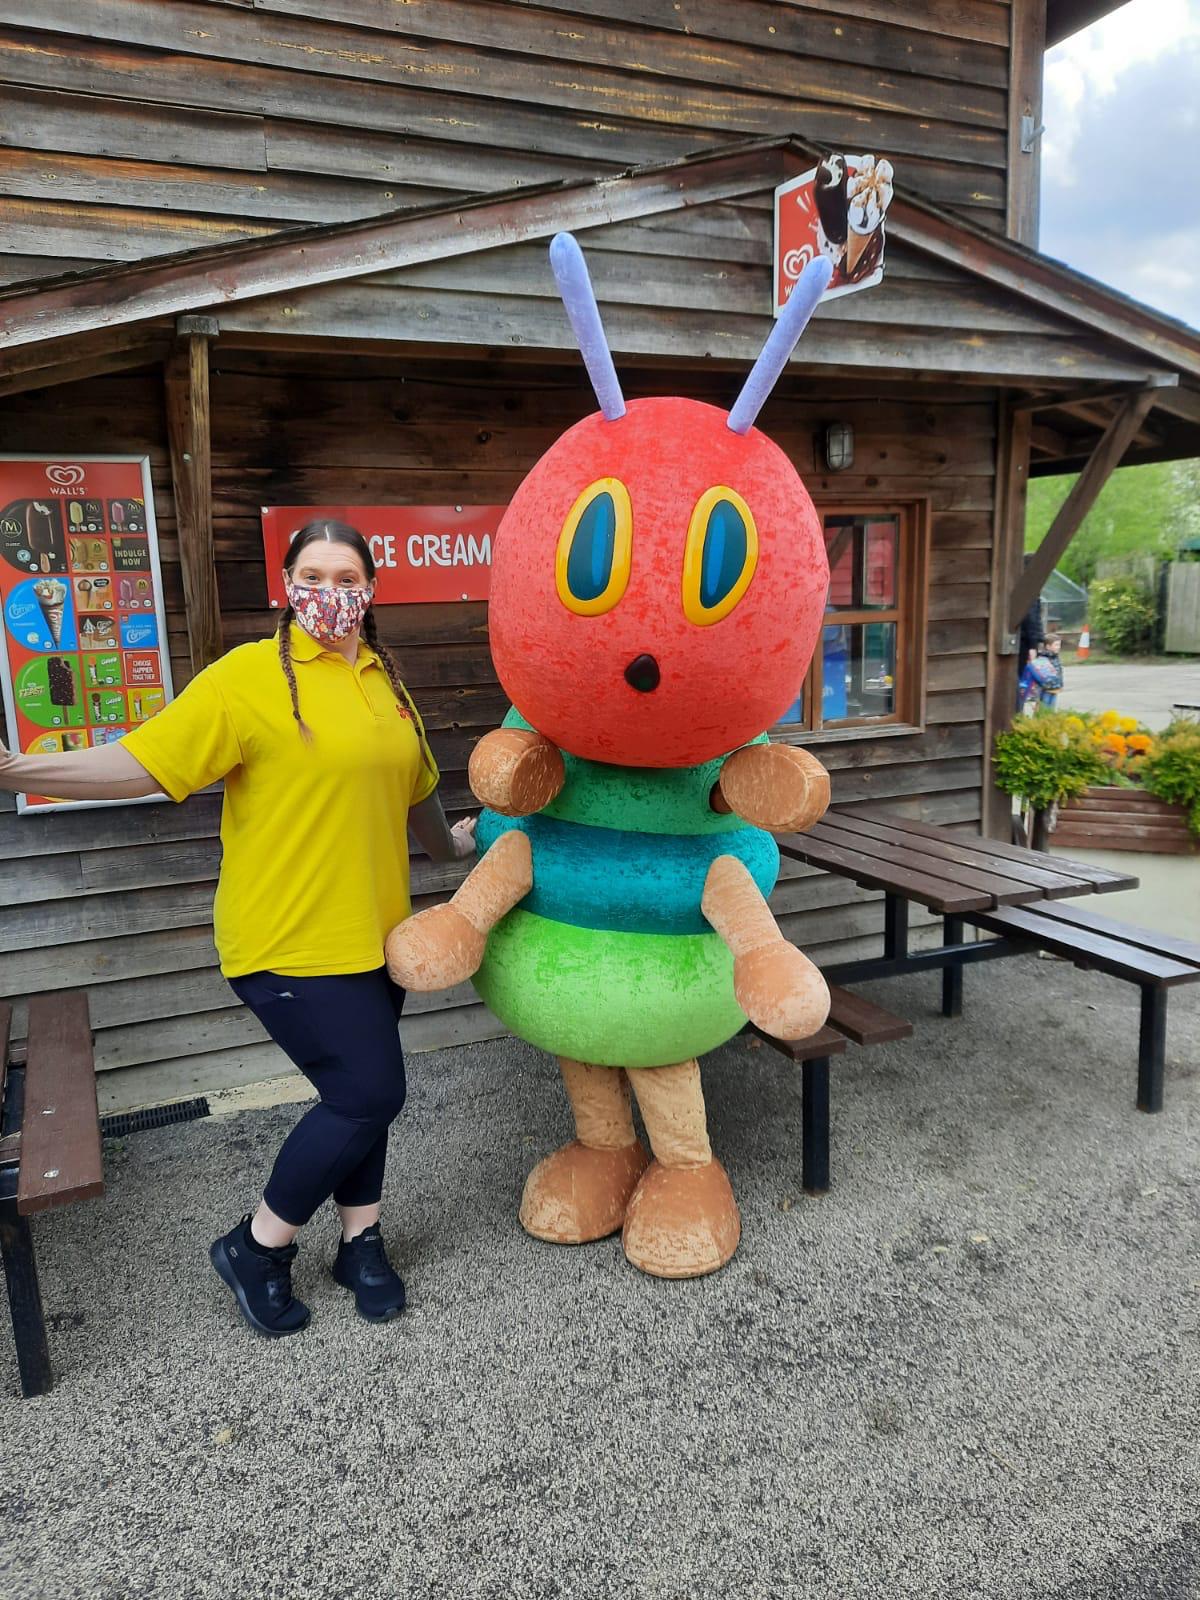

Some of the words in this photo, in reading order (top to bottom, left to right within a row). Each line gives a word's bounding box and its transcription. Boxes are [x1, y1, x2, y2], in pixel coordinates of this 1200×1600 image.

[50, 487, 85, 496] WALL'S
[114, 550, 147, 558] INDULGE
[362, 534, 397, 568] CE
[407, 533, 491, 567] CREAM
[122, 558, 141, 566] NOW
